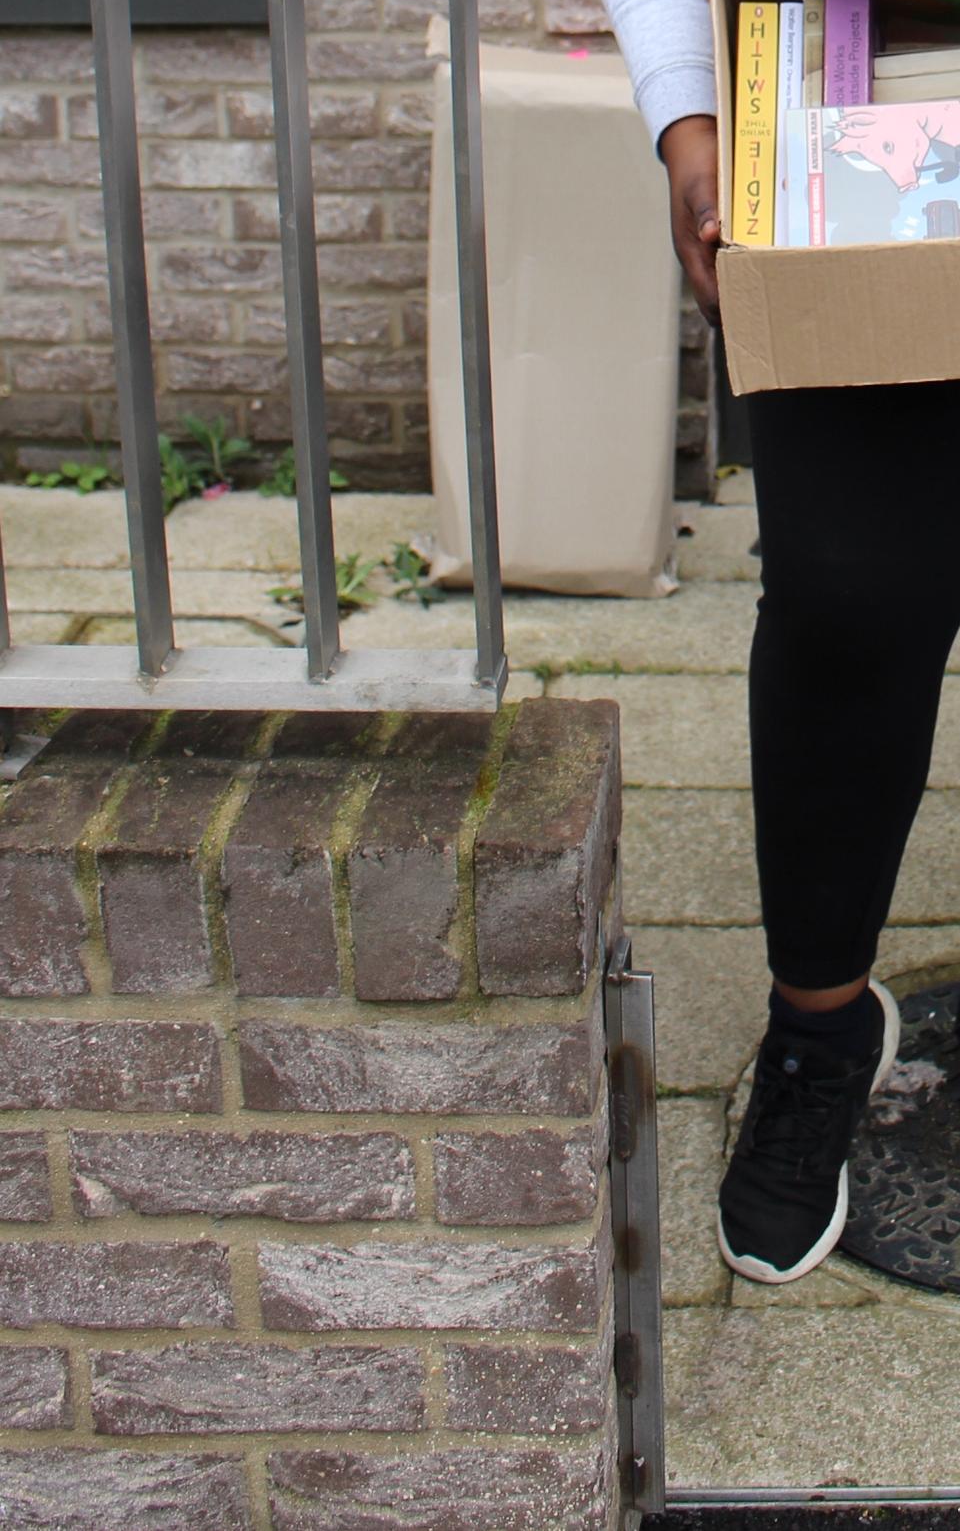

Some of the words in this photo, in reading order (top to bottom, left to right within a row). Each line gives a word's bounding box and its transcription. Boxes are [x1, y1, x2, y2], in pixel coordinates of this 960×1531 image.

[848, 11, 862, 62] Projects
[747, 22, 766, 114] SMITH
[833, 45, 845, 83] Works
[833, 86, 844, 106] ook
[744, 120, 767, 128] TIME
[810, 112, 818, 135] FARM
[811, 137, 819, 170] ANIMAL
[746, 141, 761, 236] ZADIE
